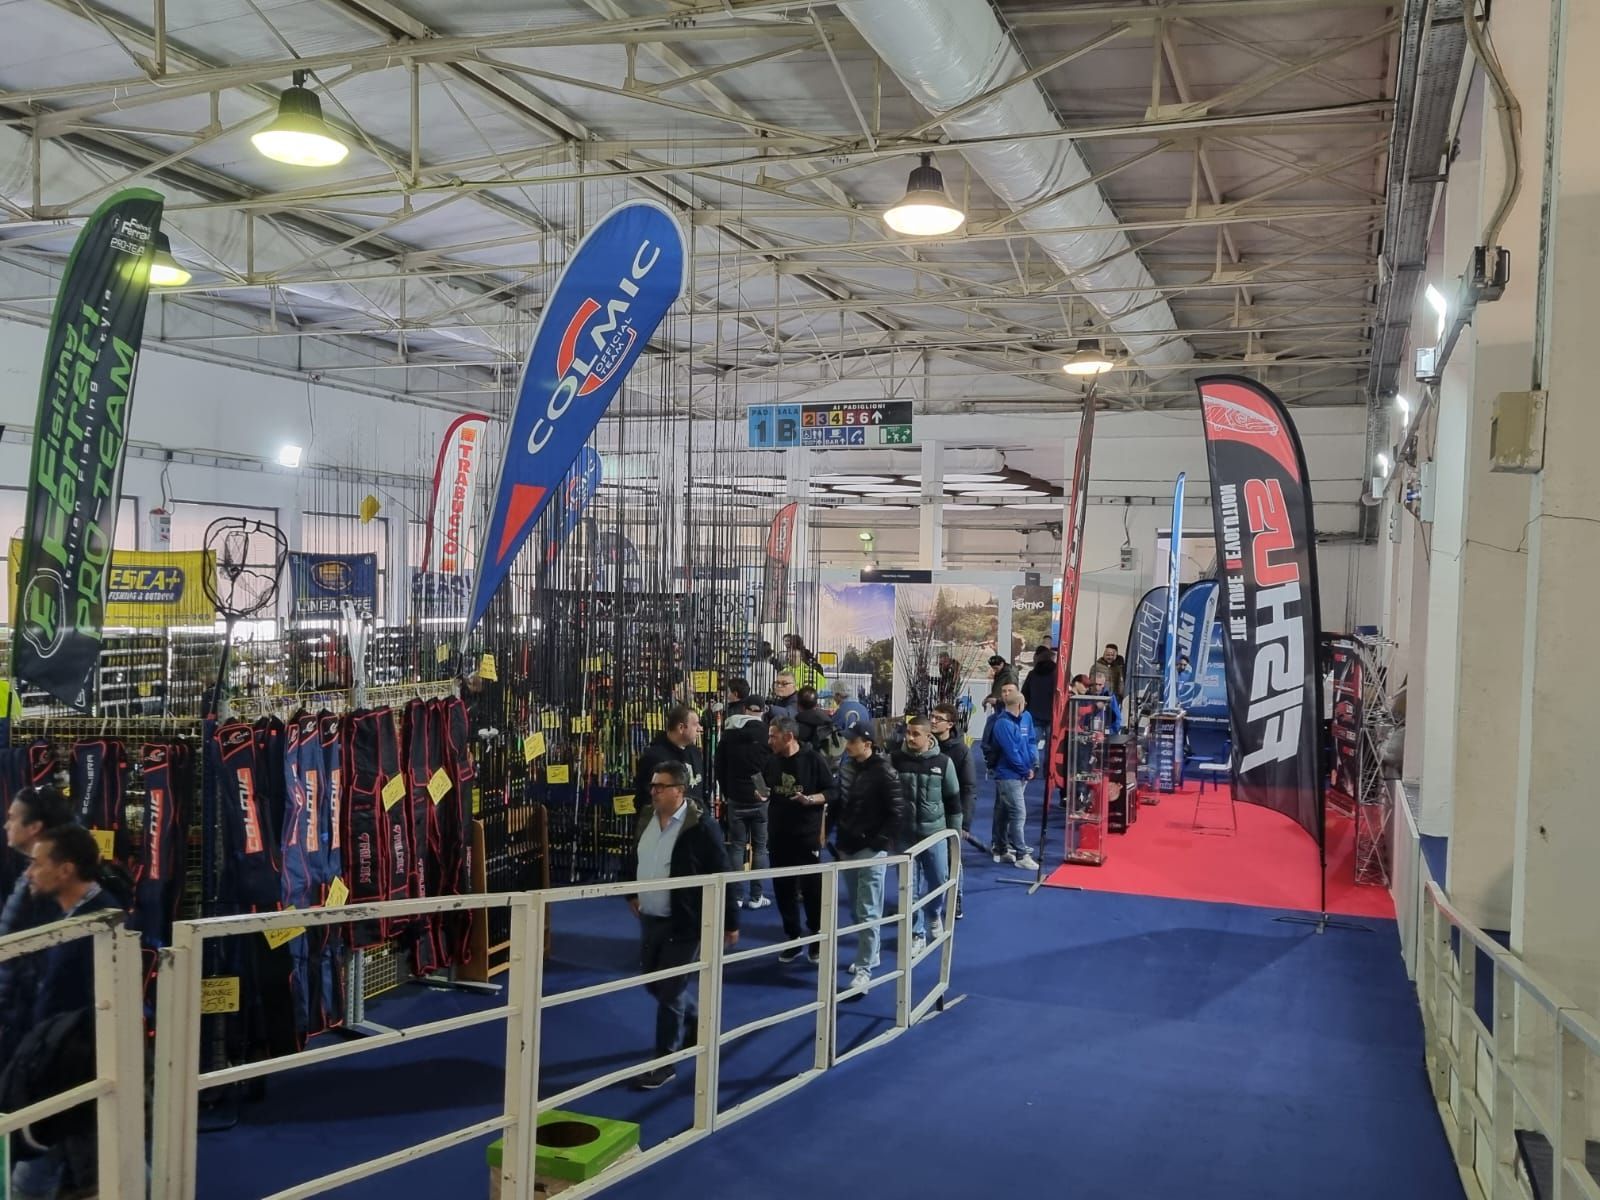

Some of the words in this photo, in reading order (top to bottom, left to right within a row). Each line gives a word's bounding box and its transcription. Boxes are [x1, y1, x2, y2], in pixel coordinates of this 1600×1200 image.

[110, 237, 146, 255] PRO-TEA
[528, 239, 661, 455] COLMIC
[596, 317, 633, 372] OFFICIAL
[600, 342, 625, 375] TEAM
[38, 322, 78, 498] Fishing
[42, 303, 99, 569] Ferrari
[755, 418, 768, 443] 1
[778, 418, 797, 442] B
[805, 413, 814, 425] 2
[818, 413, 827, 425] 3
[831, 413, 841, 424] 4
[846, 412, 855, 424] 5
[859, 412, 869, 424] 6
[76, 336, 135, 640] PRO-TEAM
[443, 445, 473, 555] TRABUCCO
[109, 569, 181, 590] ESCA+
[237, 768, 260, 851] COLMIC
